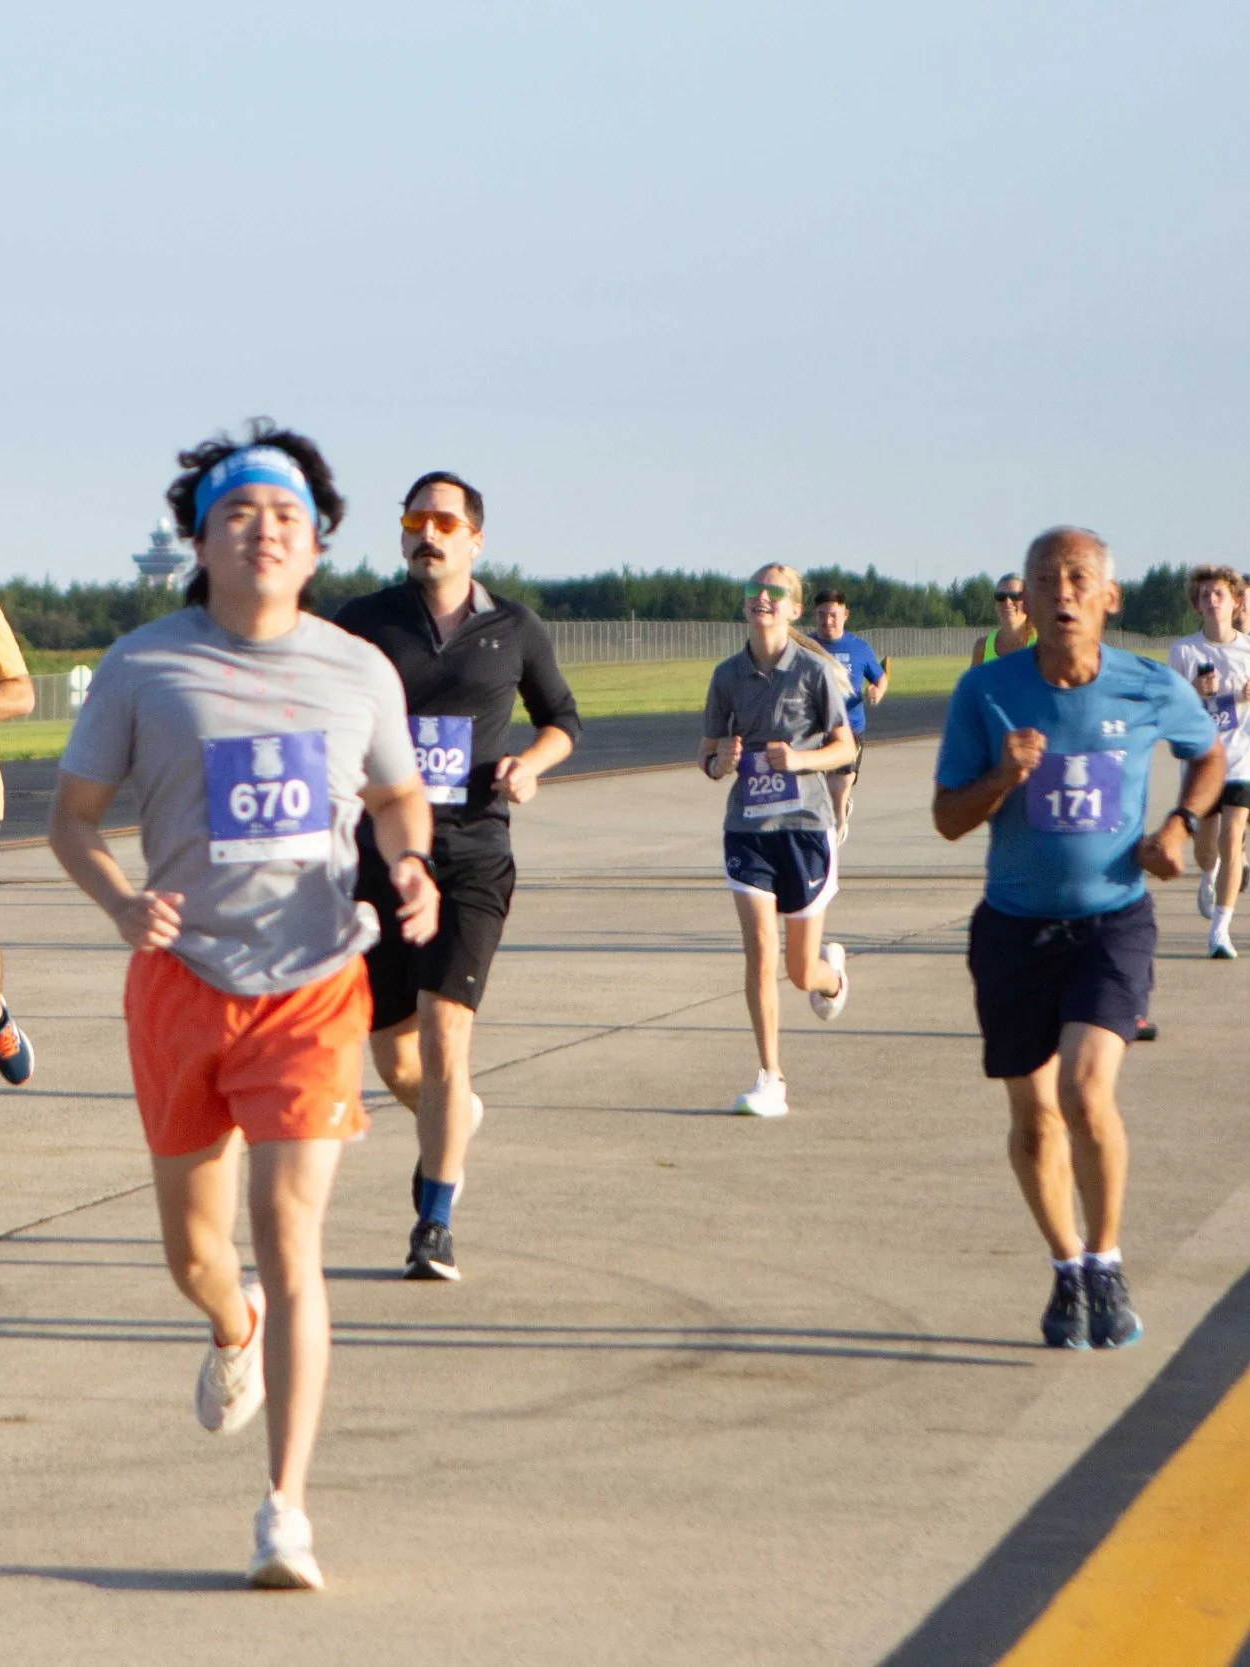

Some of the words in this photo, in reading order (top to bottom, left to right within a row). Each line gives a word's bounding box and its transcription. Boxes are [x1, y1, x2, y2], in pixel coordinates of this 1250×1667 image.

[748, 773, 786, 796] 226
[230, 779, 310, 821] 670
[1045, 788, 1102, 817] 171
